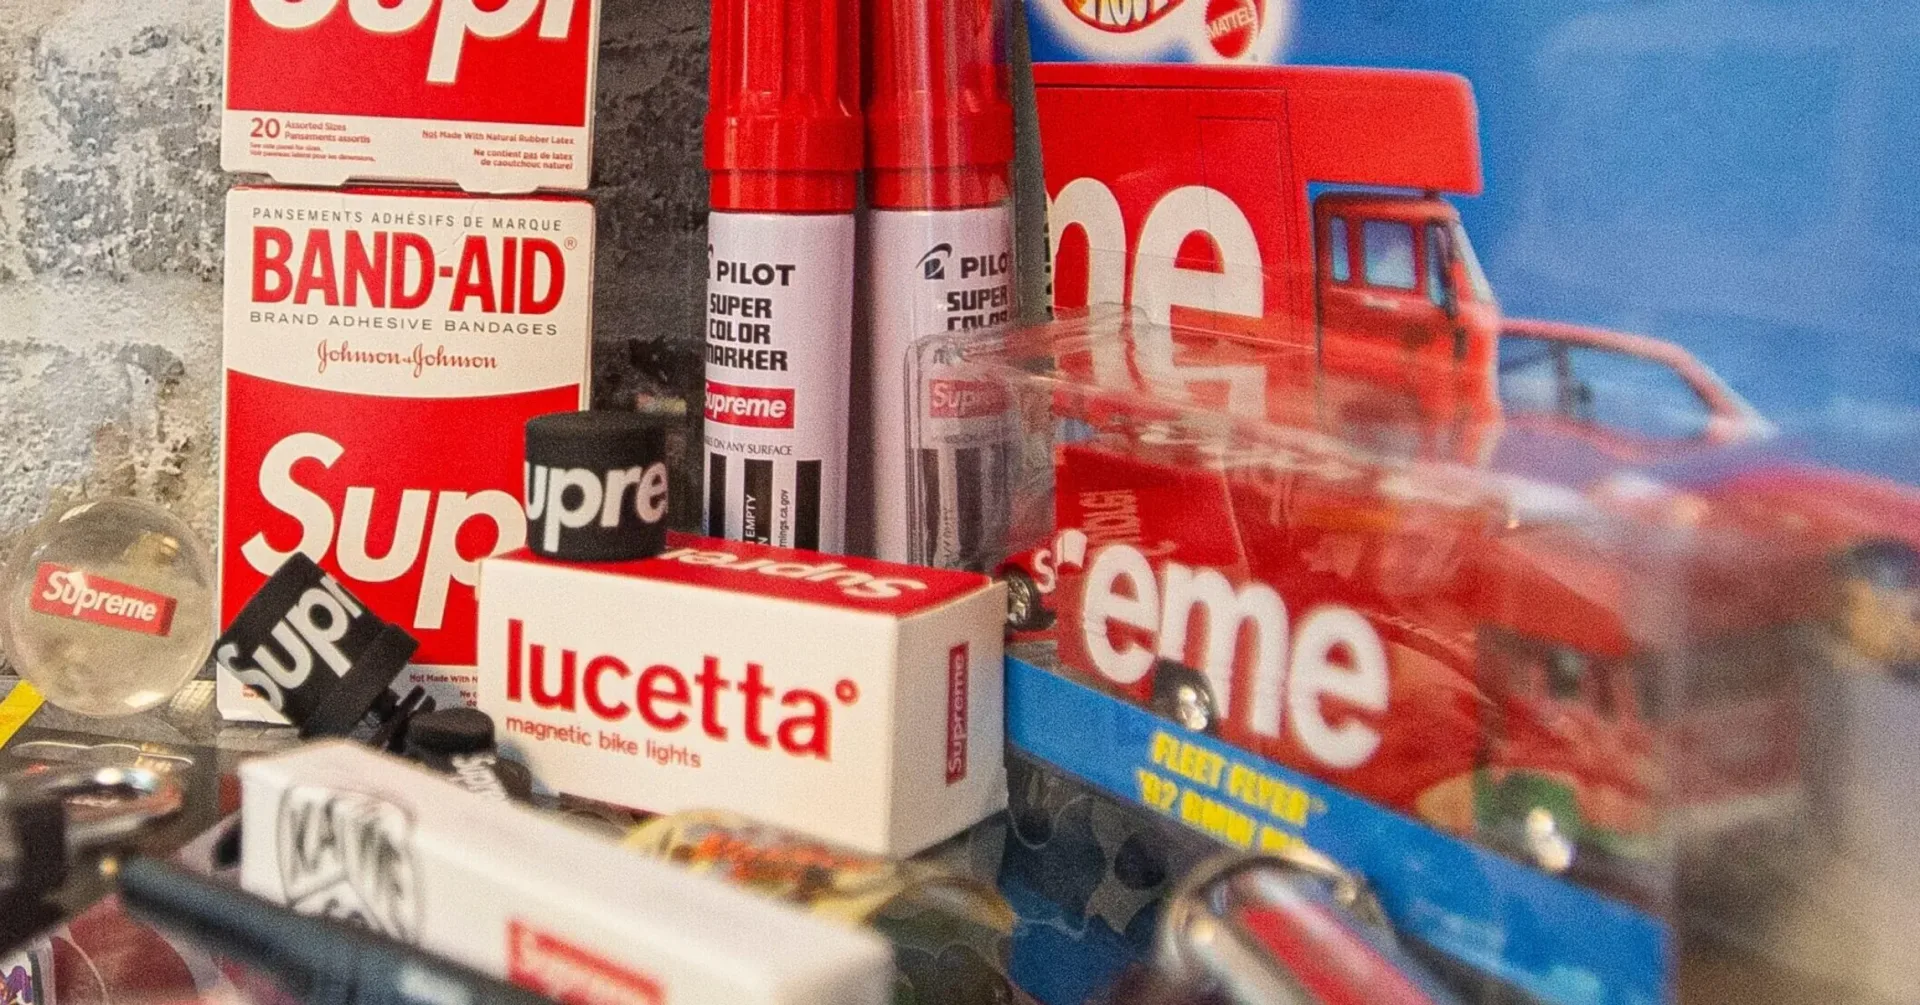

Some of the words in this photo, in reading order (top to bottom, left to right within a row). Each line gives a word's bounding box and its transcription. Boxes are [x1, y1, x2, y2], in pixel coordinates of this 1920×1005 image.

[249, 117, 281, 139] 20
[284, 120, 323, 130] Assorted
[325, 122, 347, 131] Sizes
[284, 131, 336, 142] Pansements
[338, 134, 371, 144] assortis
[422, 130, 437, 139] Not
[440, 131, 462, 140] Made
[464, 131, 484, 141] With
[486, 133, 516, 142] Natural
[519, 134, 549, 144] Rubber
[551, 135, 574, 145] Latex
[473, 148, 485, 156] Ne
[487, 149, 521, 158] contient
[523, 151, 538, 161] pas
[540, 151, 550, 160] de
[552, 152, 573, 161] latex
[480, 158, 491, 166] de
[493, 159, 541, 168] caoutchouc
[543, 161, 573, 170] naturel
[252, 207, 363, 223] PANSEMENTS
[372, 211, 455, 227] ADHÉSIFS
[464, 216, 485, 229] DE
[491, 217, 563, 232] MARQUE
[716, 260, 796, 287] PILOT
[710, 292, 773, 319] SUPER
[249, 311, 319, 325] BRAND
[328, 314, 433, 332] ADHESIVE
[445, 319, 558, 336] BANDAGES
[709, 317, 771, 345] COLOR
[705, 383, 788, 419] upreme
[726, 441, 745, 453] ANY
[747, 443, 793, 456] SURFACE
[744, 494, 757, 537] EMPTY
[41, 571, 158, 622] Supreme
[426, 674, 449, 683] Made
[450, 674, 470, 683] With
[948, 653, 967, 775] Supreme
[505, 716, 592, 746] magnetic
[599, 730, 639, 756] bike
[645, 738, 702, 768] lights
